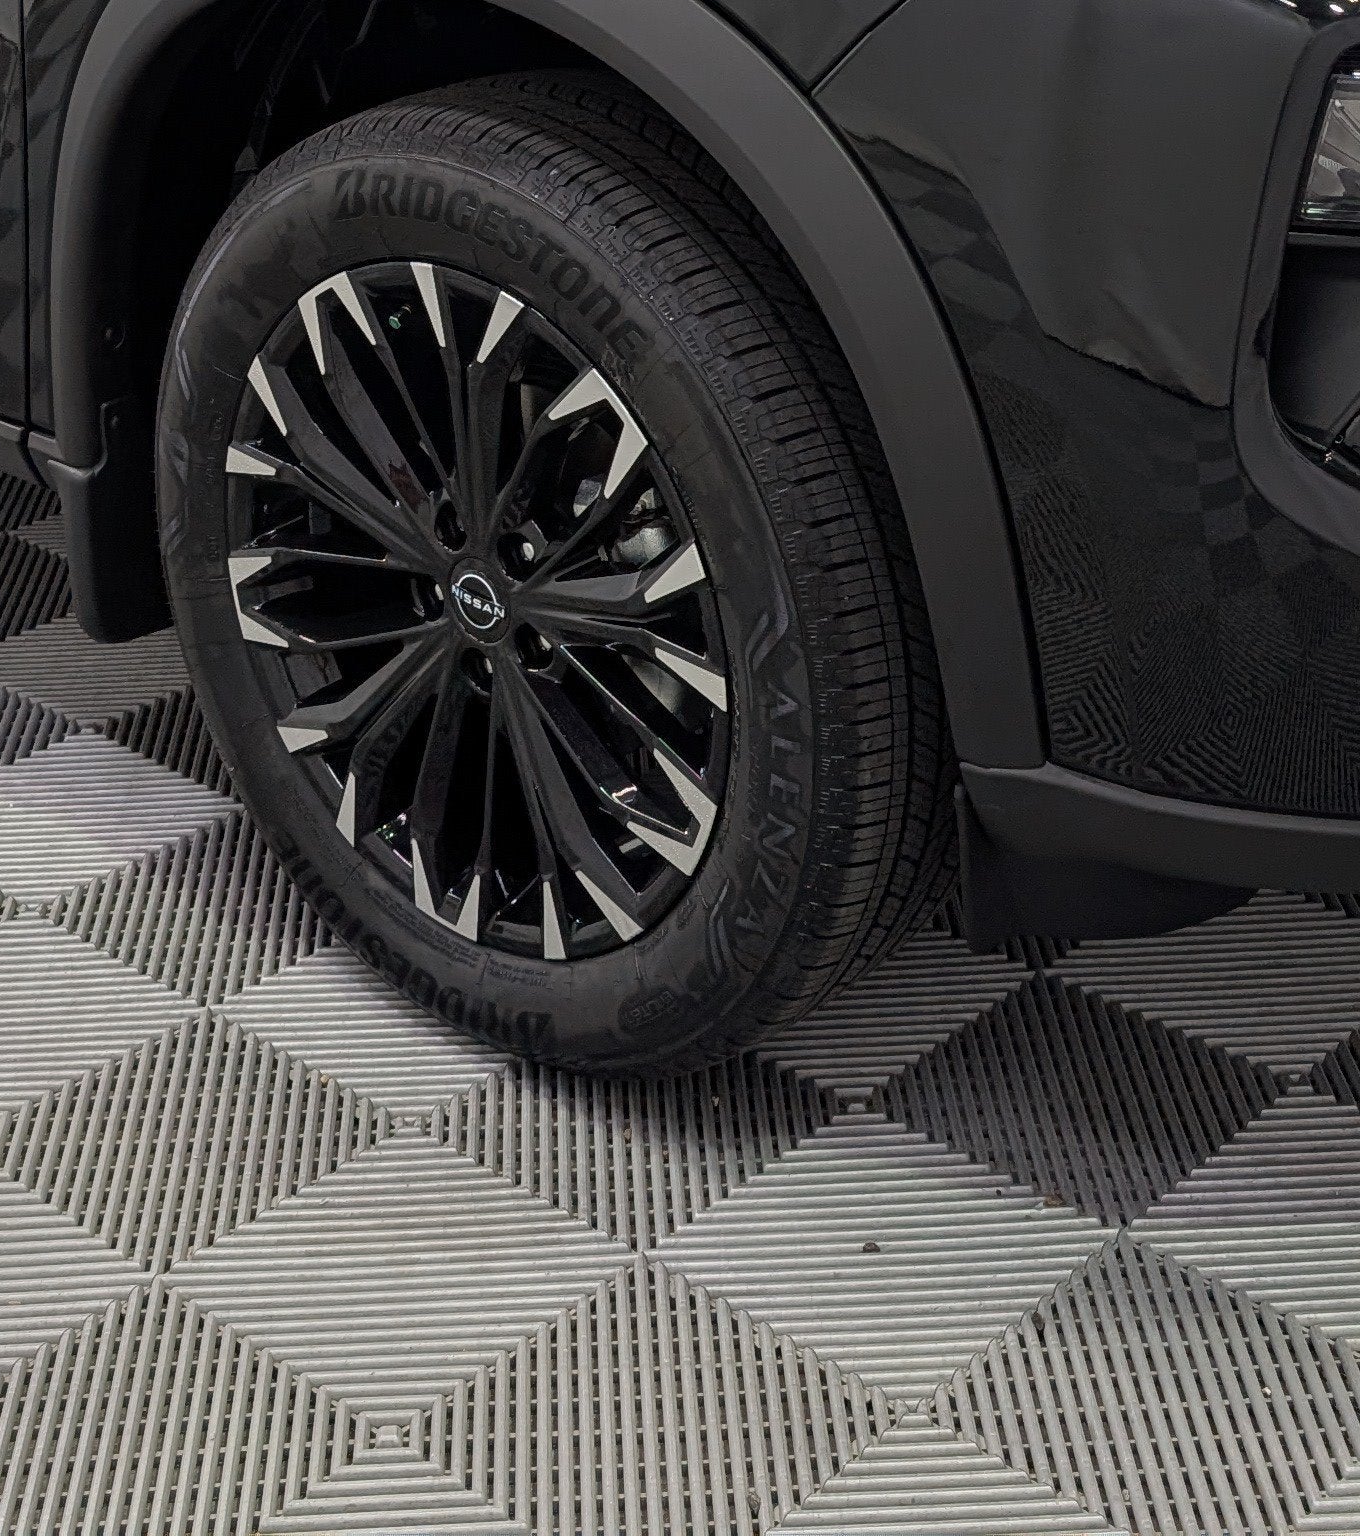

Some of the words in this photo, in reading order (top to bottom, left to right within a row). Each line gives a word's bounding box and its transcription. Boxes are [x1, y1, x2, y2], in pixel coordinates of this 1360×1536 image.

[333, 167, 658, 362] BRIDGESTONE
[451, 584, 506, 619] NISSAN
[733, 678, 803, 934] ALENZA
